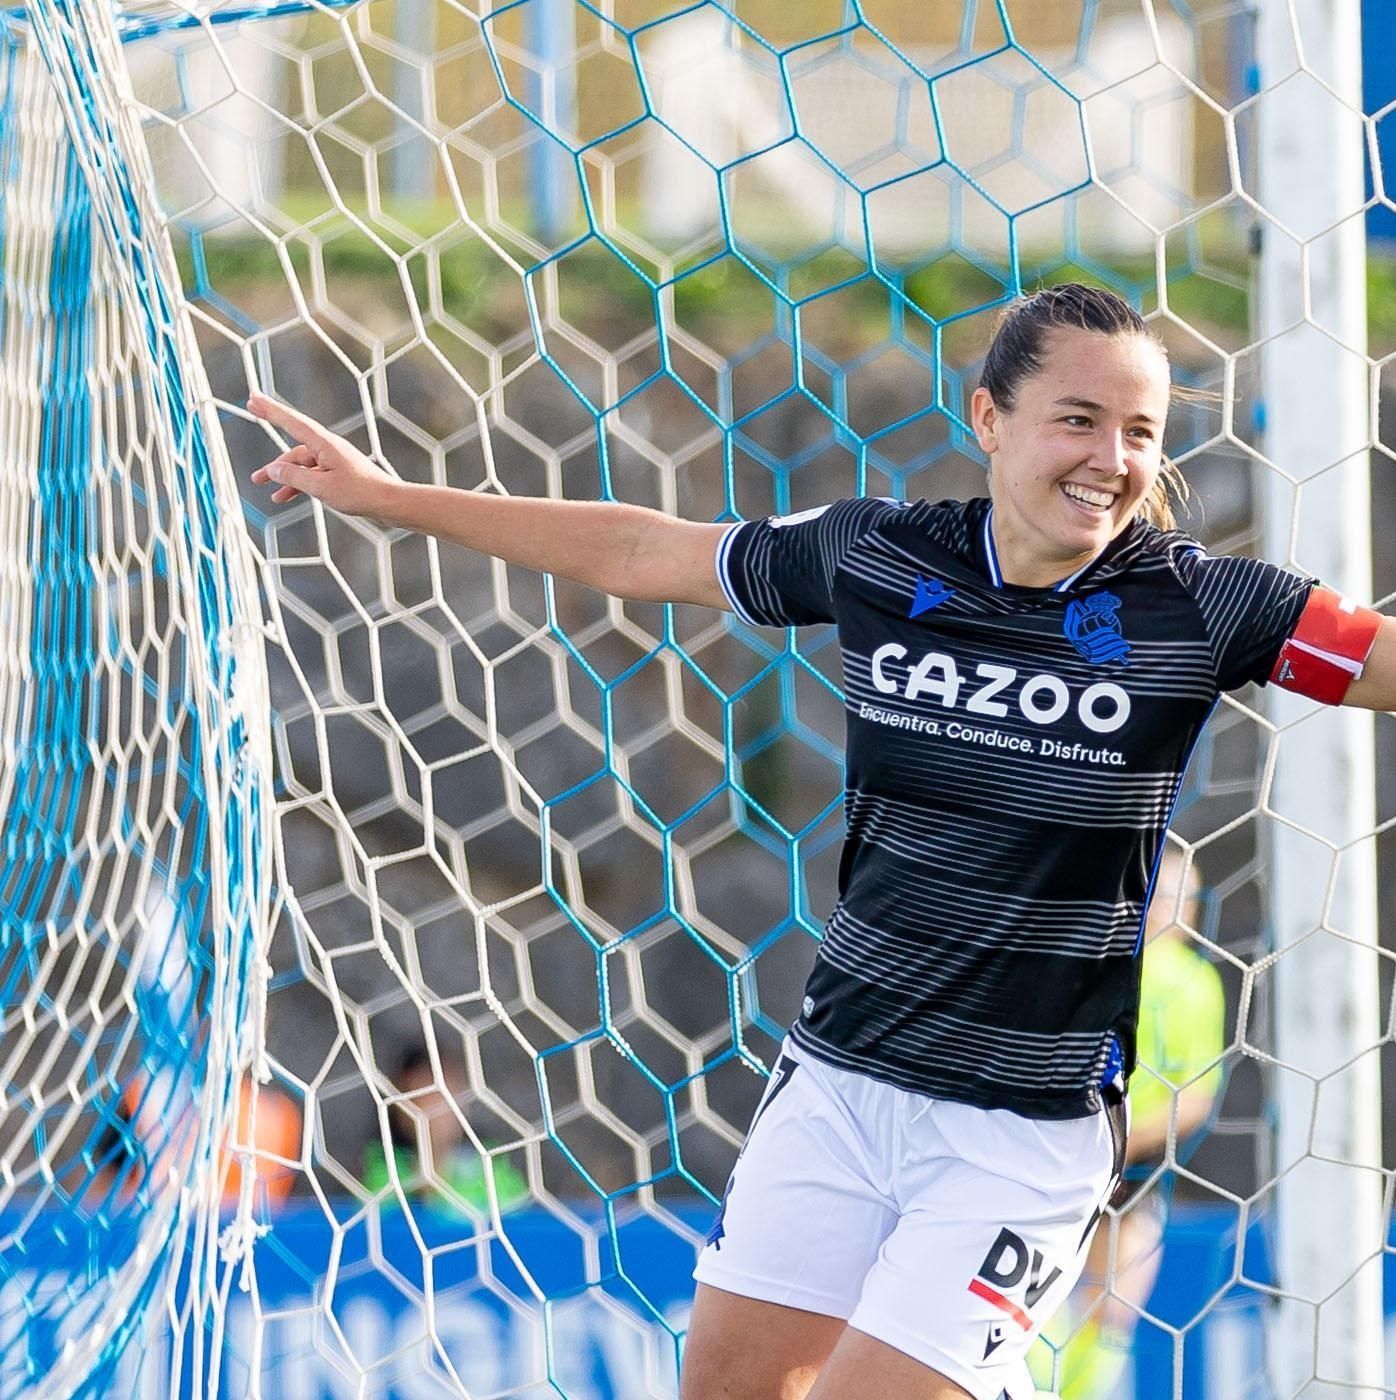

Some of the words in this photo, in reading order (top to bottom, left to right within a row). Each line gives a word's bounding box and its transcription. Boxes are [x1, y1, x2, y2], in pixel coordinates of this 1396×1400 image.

[872, 642, 1131, 733] CAZOO
[859, 702, 943, 736] Encuentra.
[945, 721, 1035, 754] Conduce.
[1039, 739, 1128, 767] Disfruta.
[977, 1226, 1063, 1310] DV
